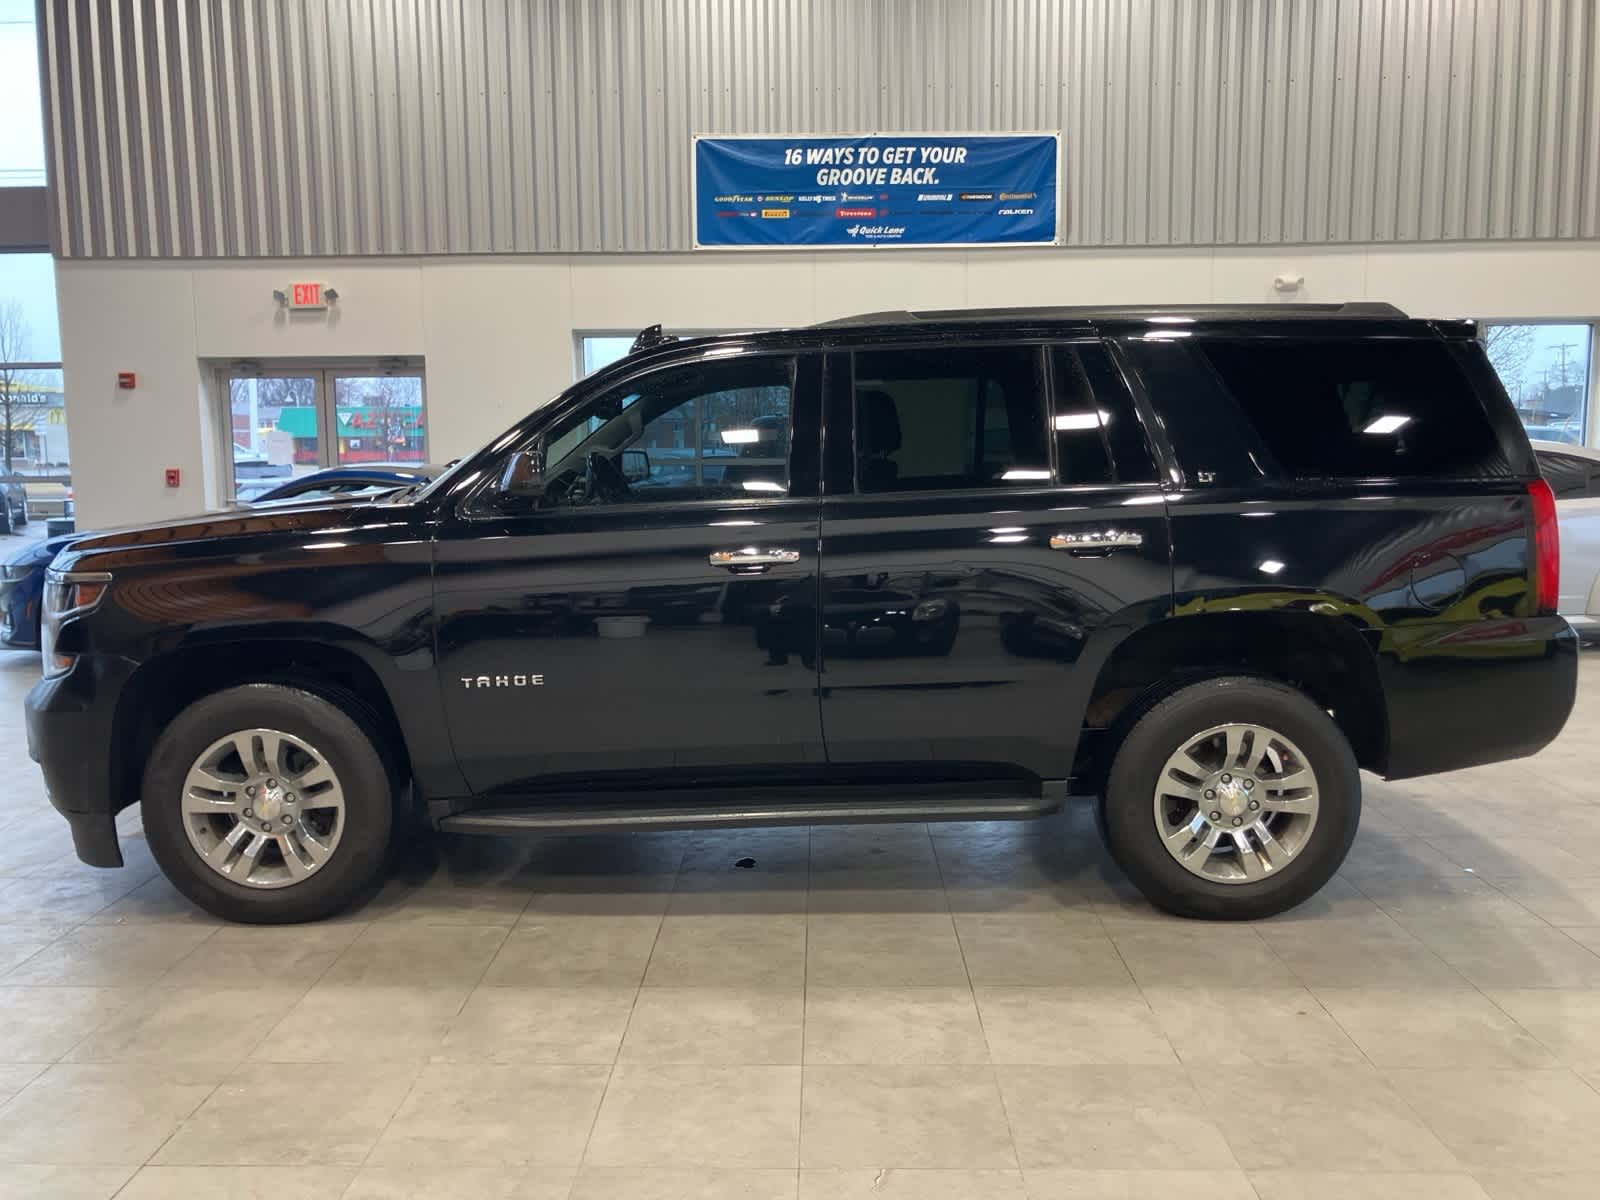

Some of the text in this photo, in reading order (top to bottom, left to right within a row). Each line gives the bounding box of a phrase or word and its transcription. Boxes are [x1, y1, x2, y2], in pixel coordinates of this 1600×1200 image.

[784, 147, 967, 165] 16 WAYS TO GET YOUR
[816, 167, 940, 186] GROOVE BACK.
[998, 208, 1034, 216] FALKEN
[859, 226, 905, 235] Quick Lane
[294, 284, 320, 305] EXIT
[1197, 471, 1216, 483] LT
[461, 674, 544, 689] TAHOE
